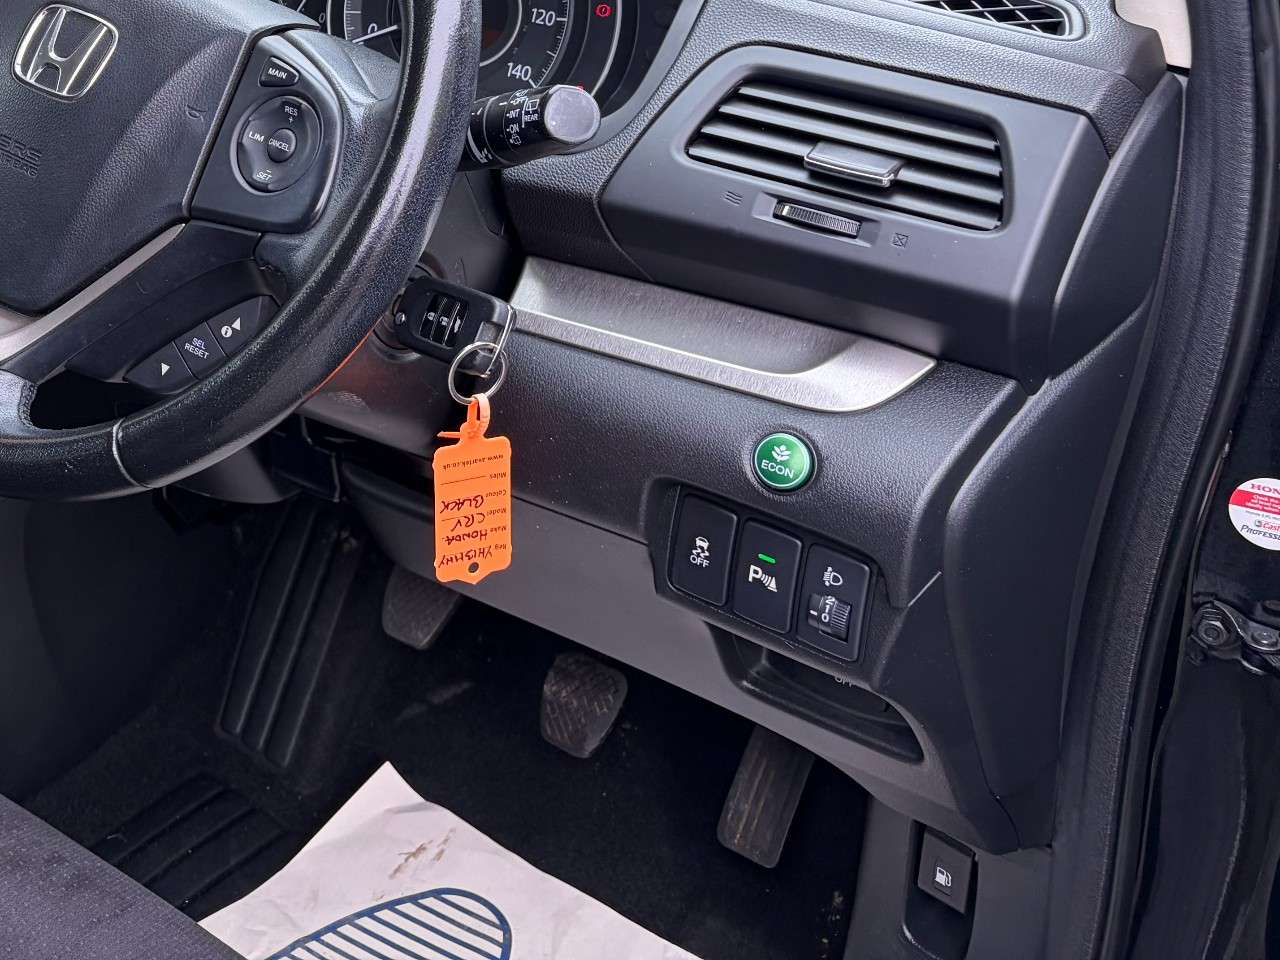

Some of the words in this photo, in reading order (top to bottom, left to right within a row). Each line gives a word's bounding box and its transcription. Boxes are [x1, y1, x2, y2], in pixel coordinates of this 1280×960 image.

[318, 12, 326, 24] 0
[531, 7, 556, 26] 120
[267, 67, 288, 80] MAIN
[507, 62, 532, 81] 140
[284, 105, 298, 117] RES
[509, 108, 521, 119] INT
[524, 113, 539, 122] REAR
[509, 122, 520, 134] ON
[248, 131, 265, 142] LIM
[268, 138, 290, 152] CANCEL
[257, 171, 272, 181] SET
[191, 337, 206, 350] SEL
[184, 343, 210, 359] RESET
[761, 459, 795, 479] ECON
[489, 471, 506, 480] Miles
[485, 489, 507, 498] Colour
[440, 494, 485, 514] BLACK
[486, 507, 507, 517] Model
[451, 512, 486, 532] CRV
[490, 525, 507, 533] Make
[689, 554, 710, 568] OFF
[825, 595, 836, 605] 2
